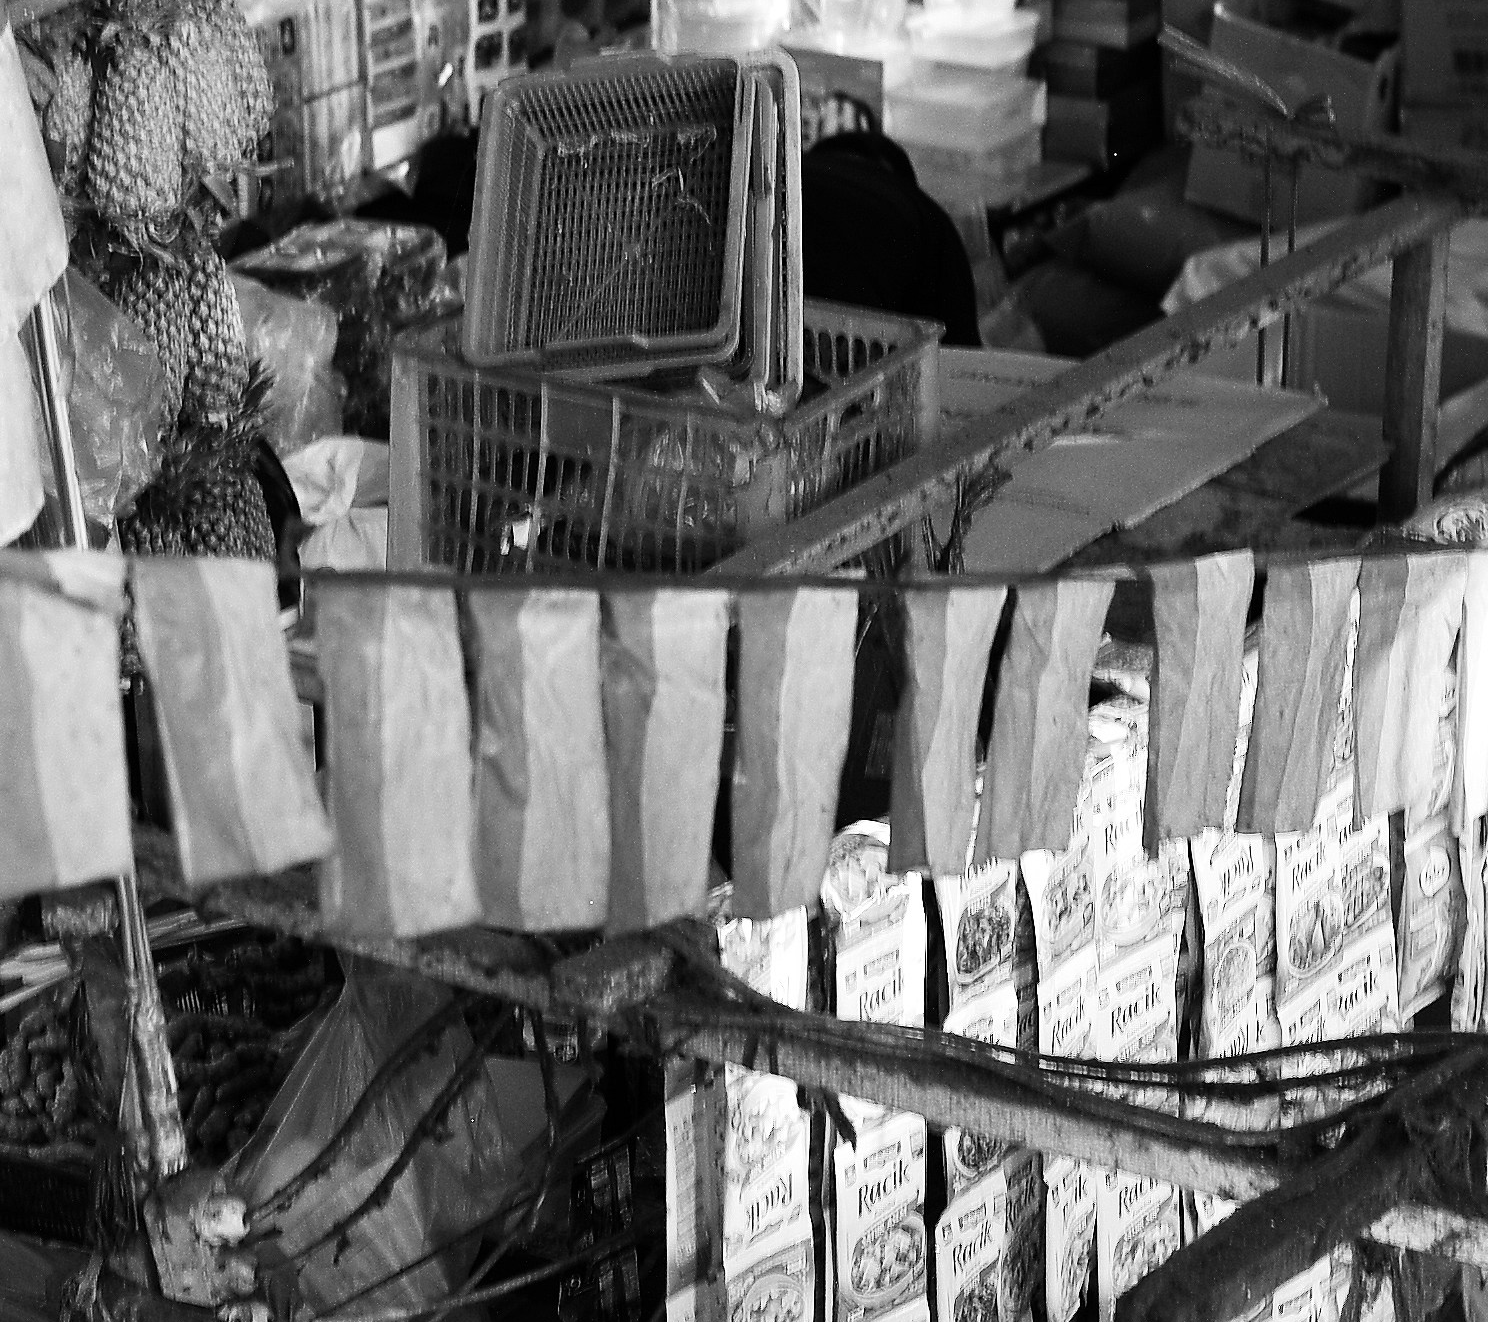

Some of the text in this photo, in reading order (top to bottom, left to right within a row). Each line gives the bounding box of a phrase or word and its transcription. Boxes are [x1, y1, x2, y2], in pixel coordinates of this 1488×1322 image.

[1111, 983, 1162, 1033] Racik
[744, 1173, 793, 1232] Racik
[858, 1160, 911, 1220] Racik
[953, 1222, 993, 1274] Racik
